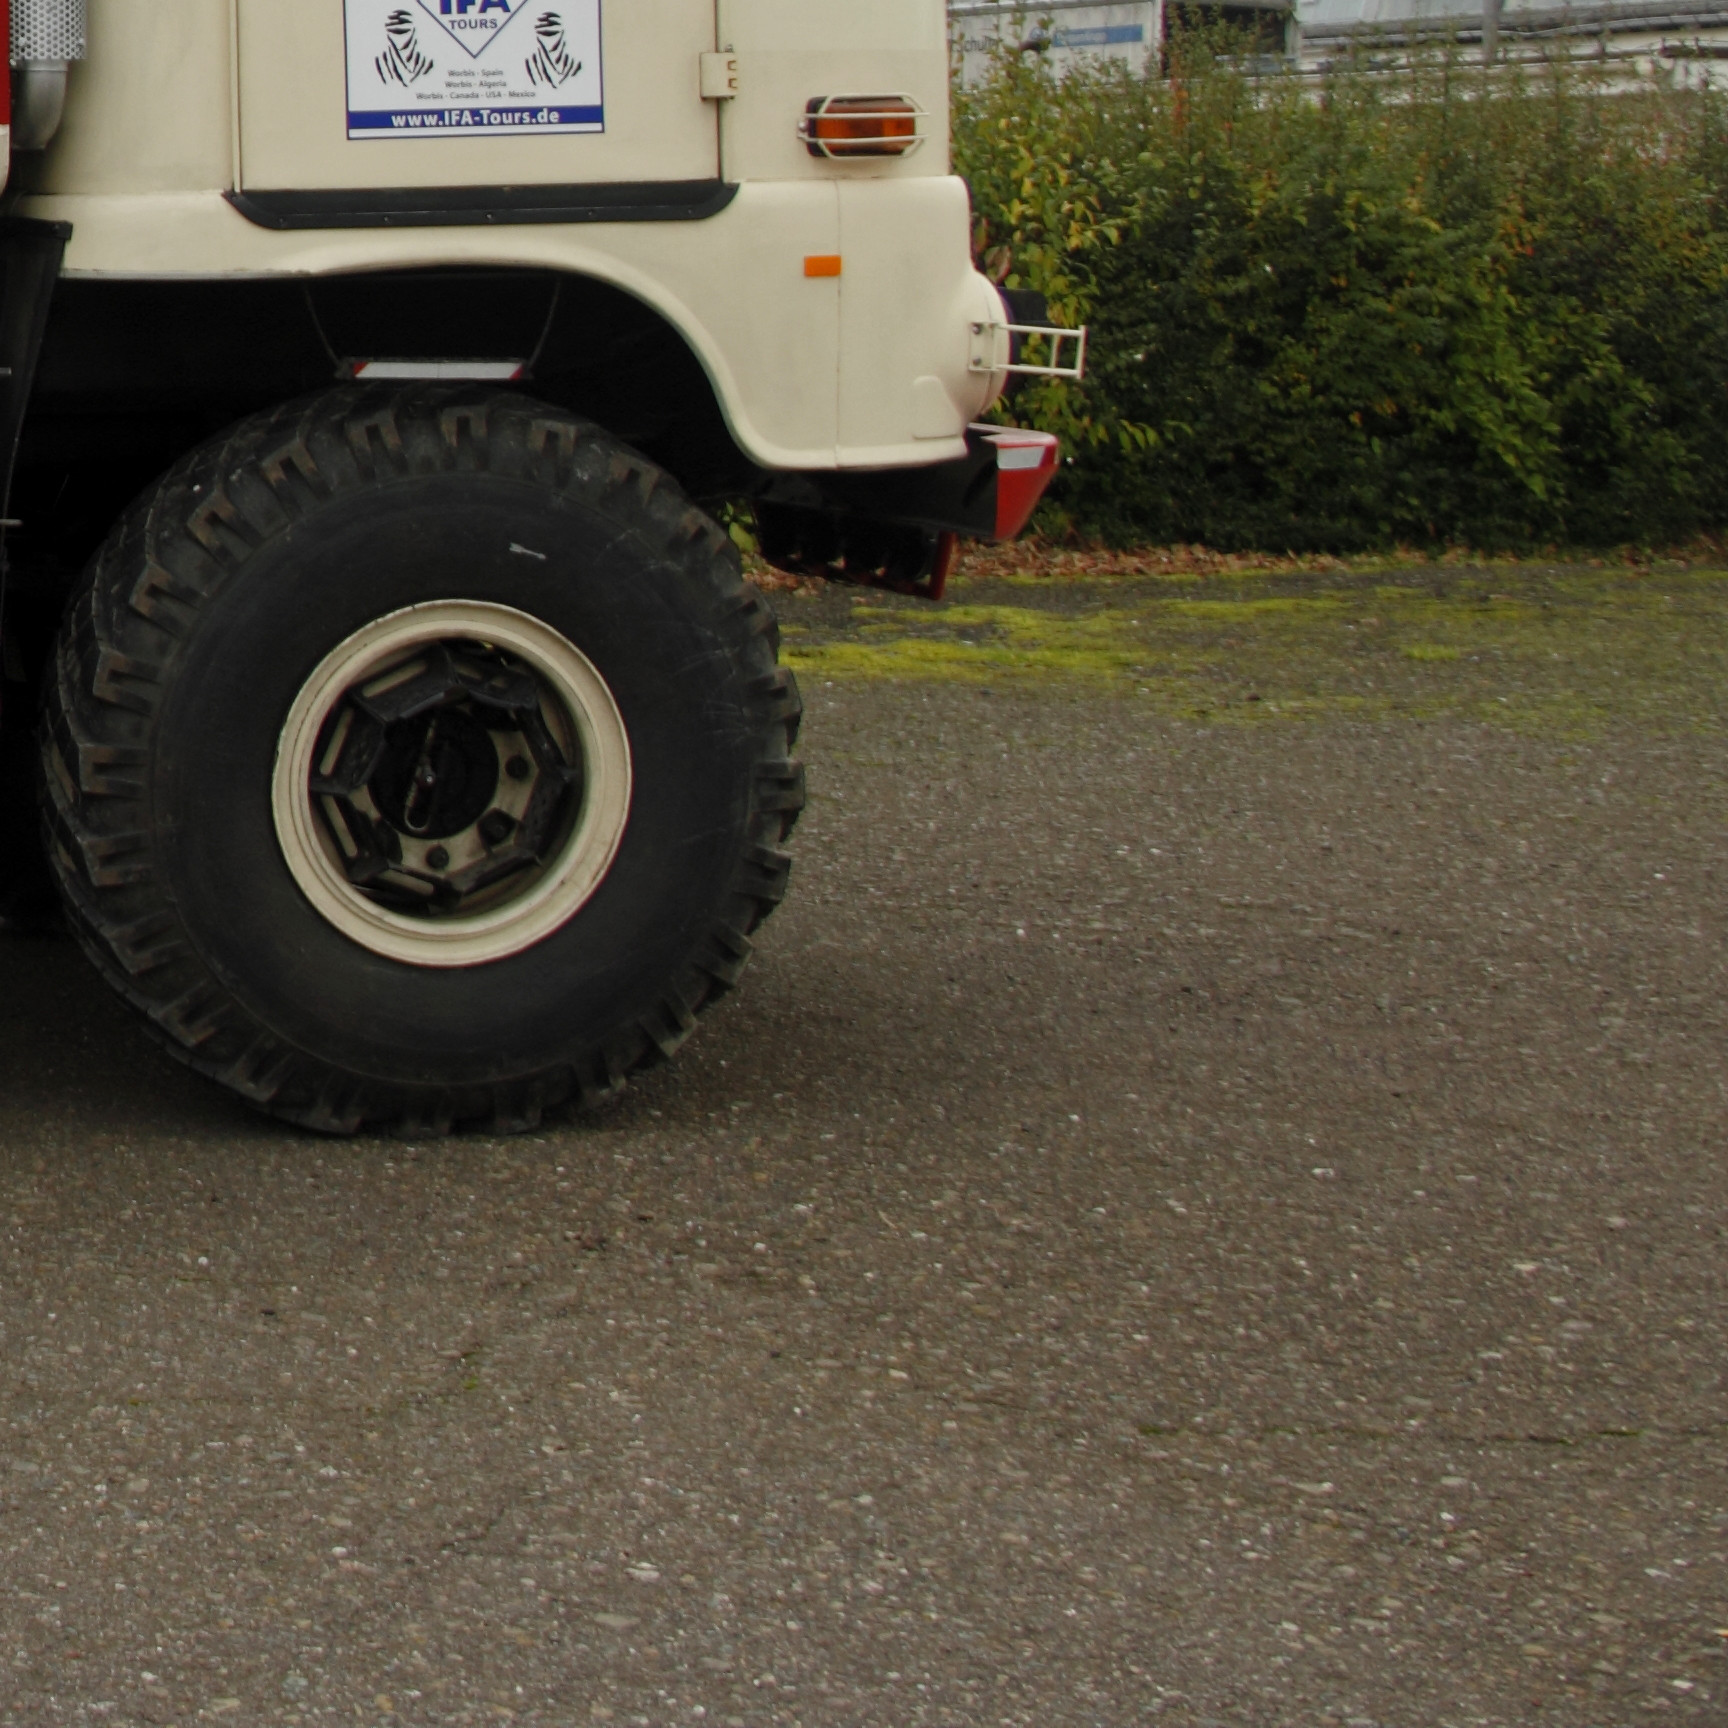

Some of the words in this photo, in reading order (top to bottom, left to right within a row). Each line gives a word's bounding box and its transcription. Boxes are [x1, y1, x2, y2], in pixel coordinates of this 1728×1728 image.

[449, 19, 498, 31] TOURS
[486, 91, 502, 99] USA
[391, 108, 560, 128] www.IFA-Tours.de
